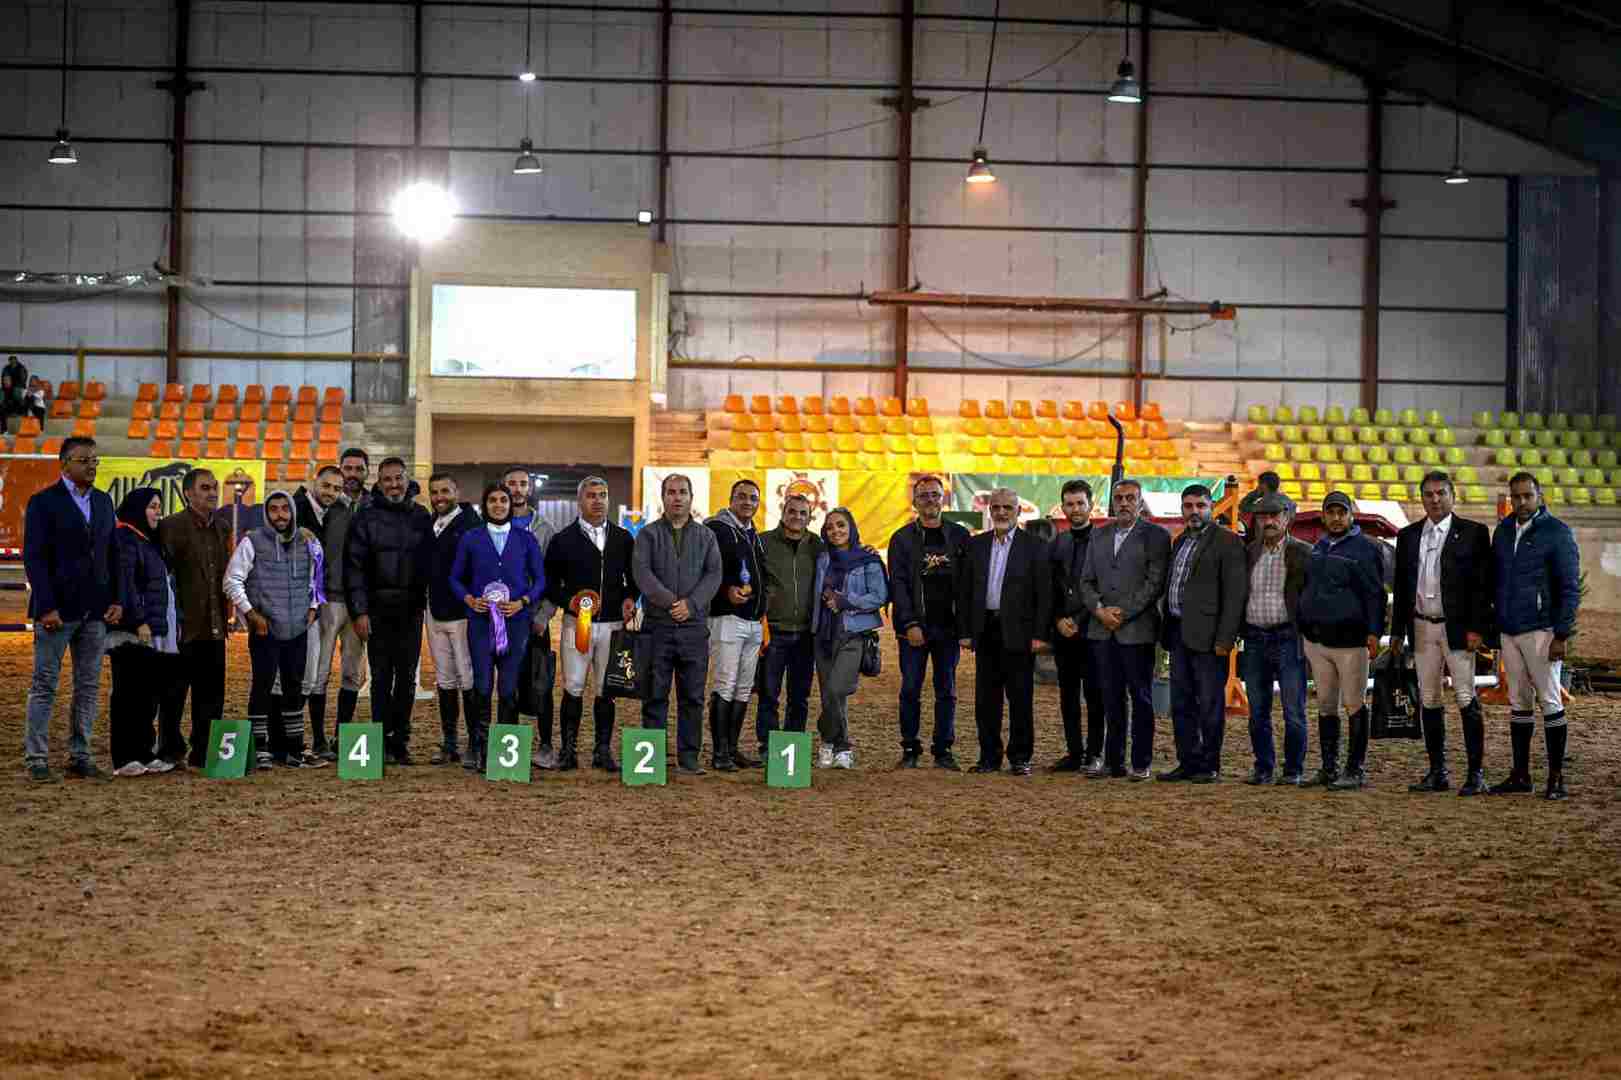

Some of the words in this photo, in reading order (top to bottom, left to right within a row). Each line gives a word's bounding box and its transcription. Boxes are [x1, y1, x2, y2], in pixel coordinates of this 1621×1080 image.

[218, 732, 237, 760] 5
[348, 734, 371, 767] 4
[498, 734, 520, 768] 3
[633, 741, 655, 774] 2
[780, 743, 796, 776] 1
